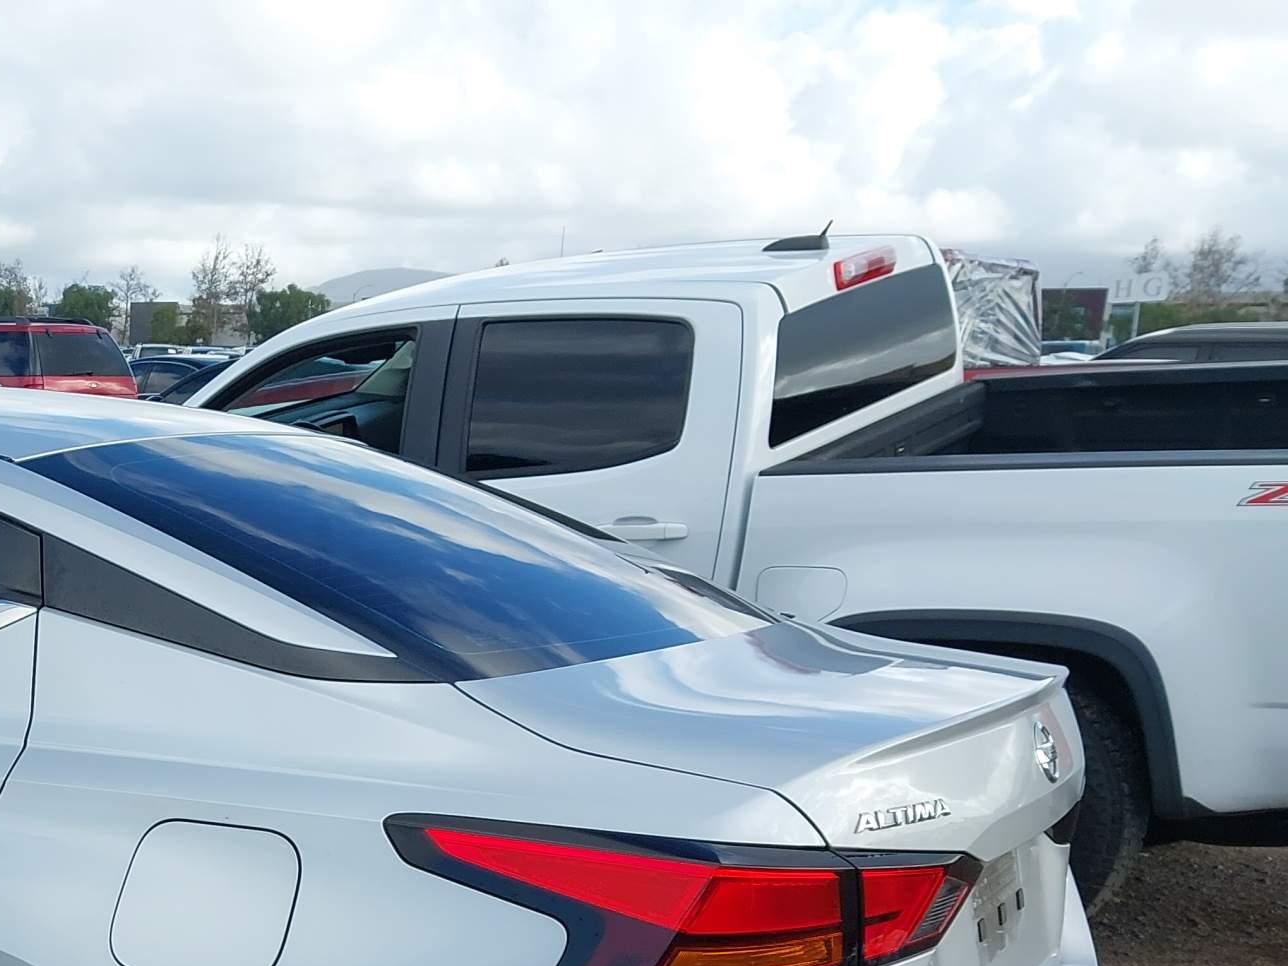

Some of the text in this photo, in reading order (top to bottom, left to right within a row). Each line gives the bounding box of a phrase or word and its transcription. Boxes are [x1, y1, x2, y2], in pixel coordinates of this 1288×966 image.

[1114, 277, 1163, 298] H G
[853, 798, 951, 834] ALTIMA
